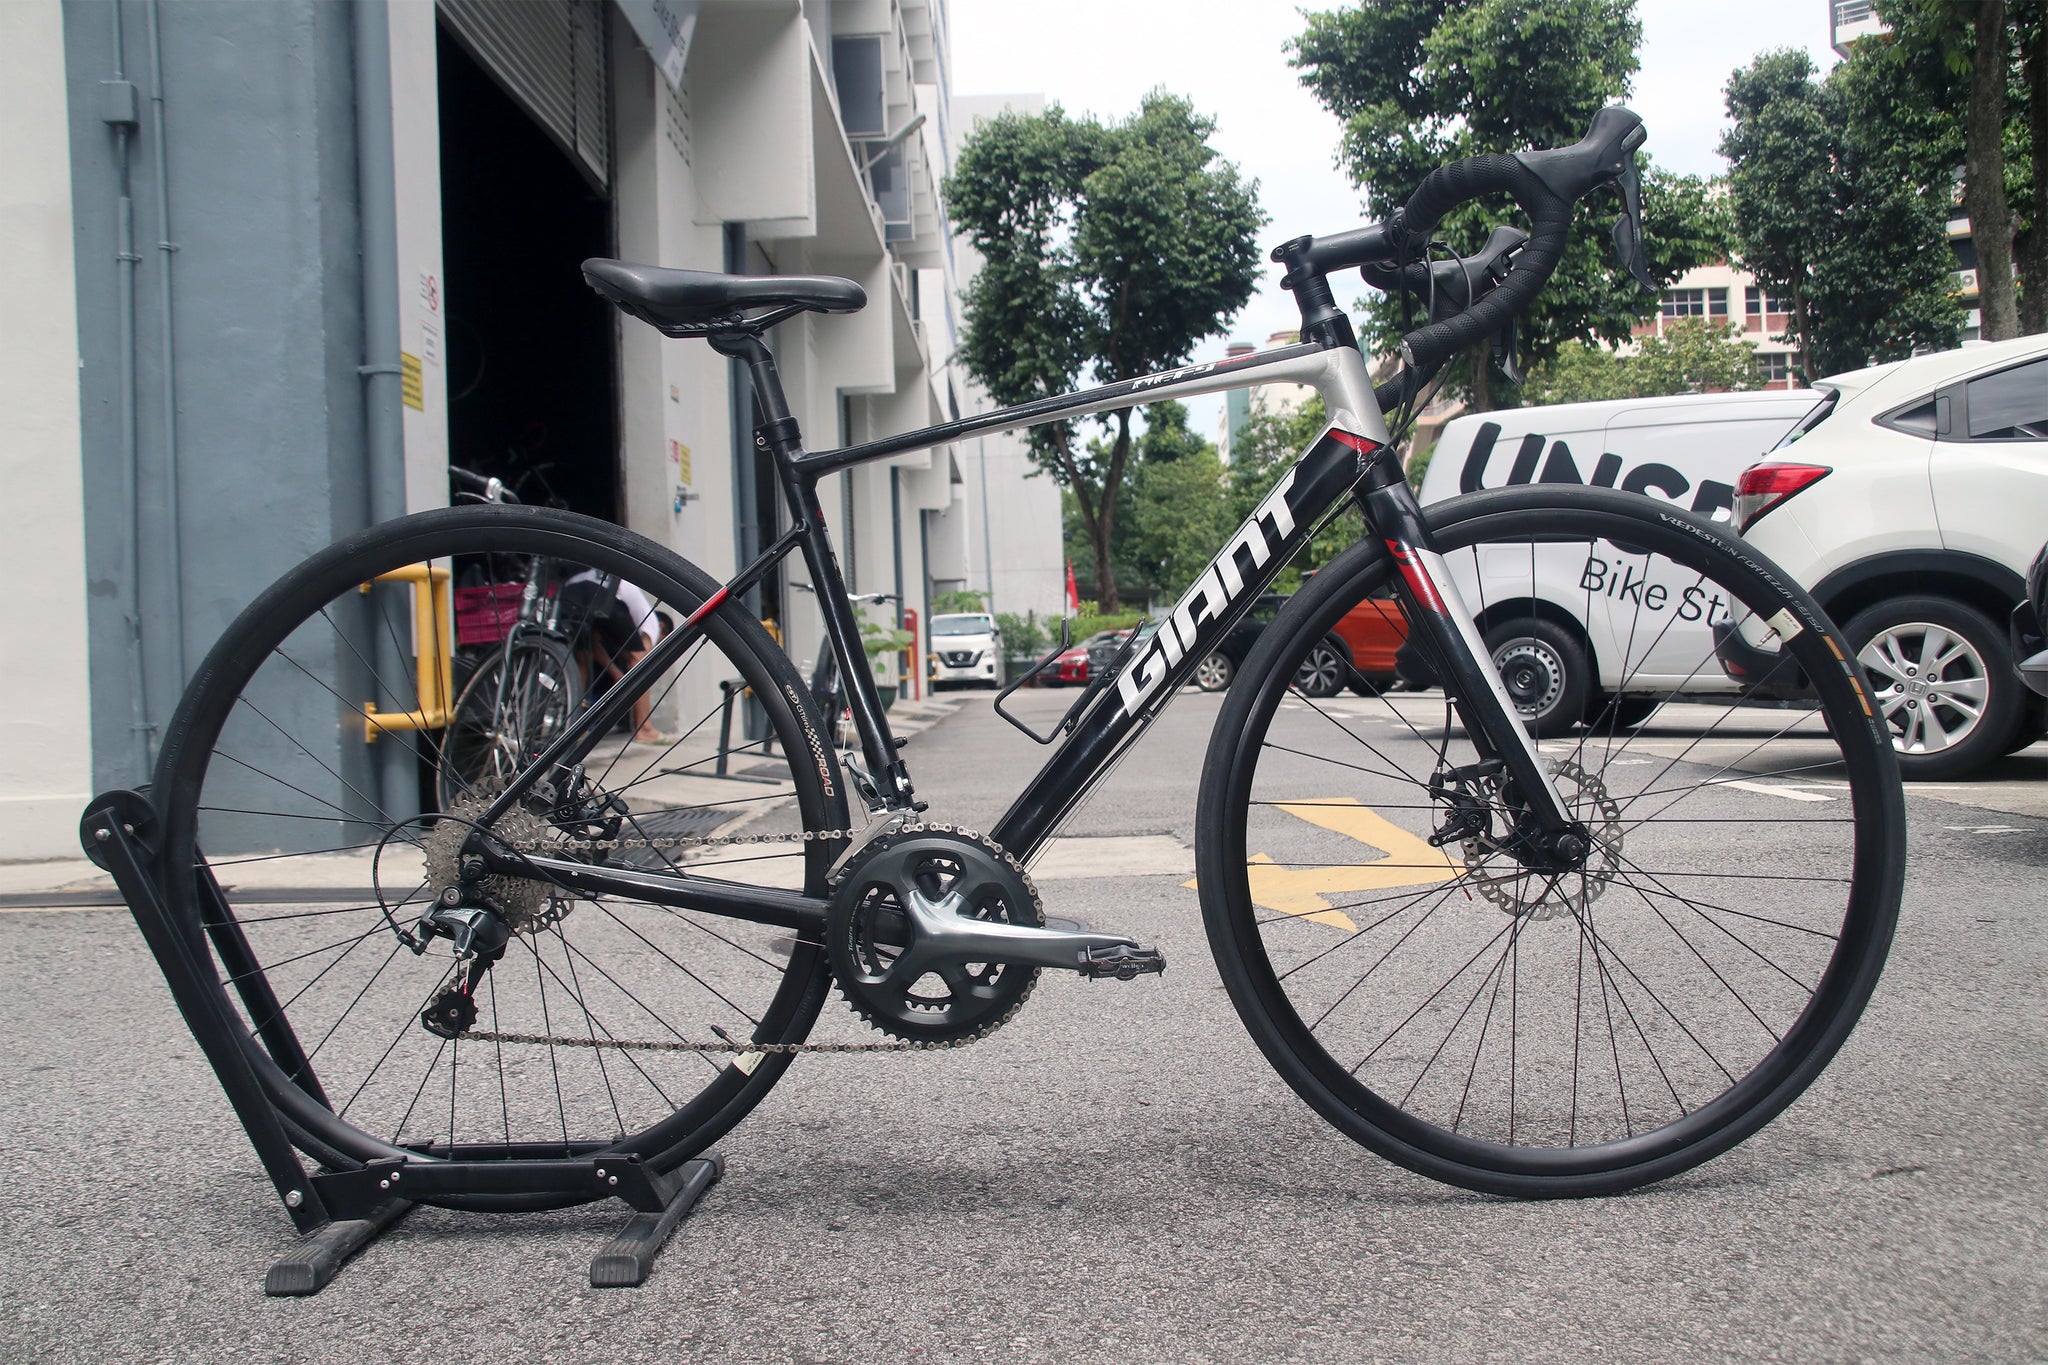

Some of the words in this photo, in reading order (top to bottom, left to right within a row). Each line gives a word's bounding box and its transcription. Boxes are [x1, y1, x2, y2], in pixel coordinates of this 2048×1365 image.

[1117, 466, 1297, 718] GIANT
[1579, 557, 1668, 611] Bike
[1678, 586, 1729, 628] St
[1659, 512, 1738, 557] VREDESTEIN
[1736, 554, 1793, 600] FORTEZZA
[1790, 599, 1825, 634] SENSO
[816, 758, 835, 798] ROAD
